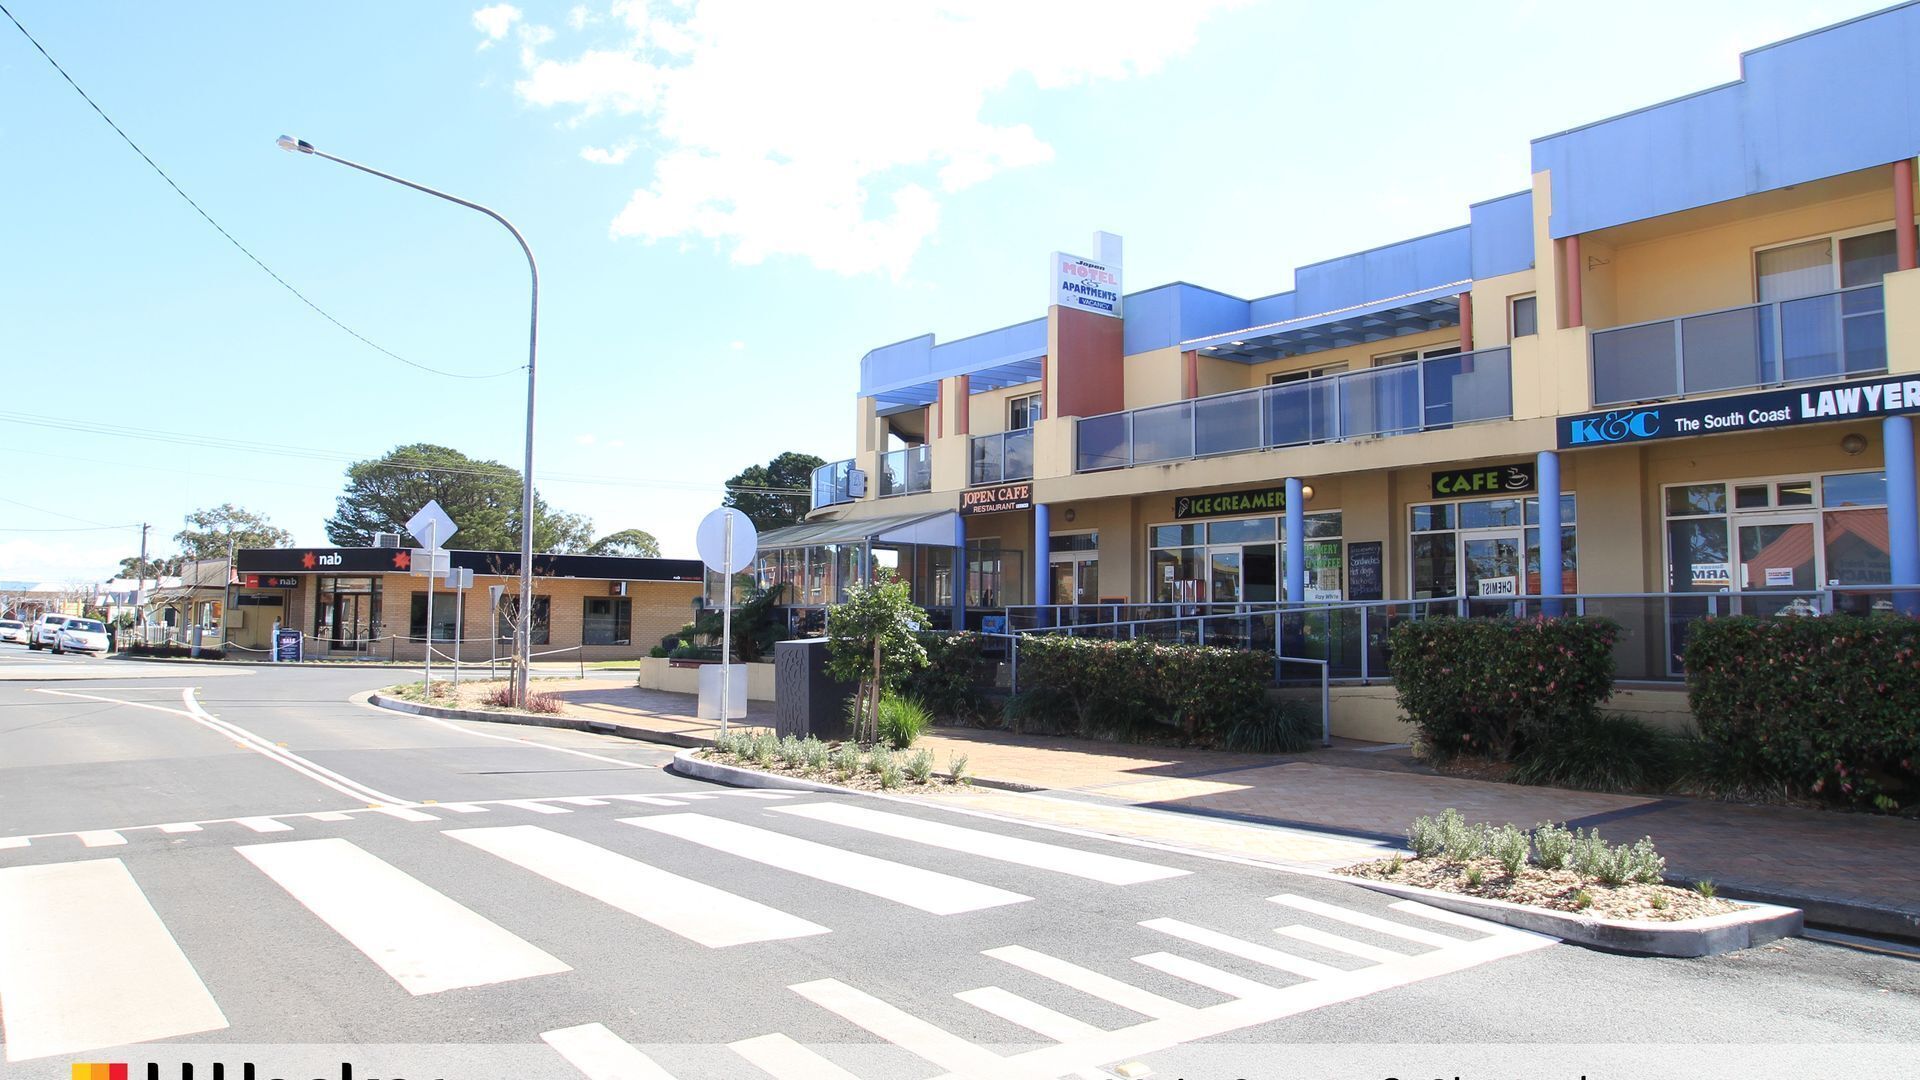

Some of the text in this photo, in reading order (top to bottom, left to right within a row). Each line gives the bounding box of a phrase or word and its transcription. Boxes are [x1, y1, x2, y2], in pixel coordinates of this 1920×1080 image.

[1062, 262, 1117, 285] MOTEL
[1062, 281, 1117, 302] APARTMENTS
[1081, 298, 1110, 309] VACANCY
[1569, 381, 1920, 444] K&C The South Coast LAWYER
[1436, 471, 1499, 493] CAFE
[962, 485, 1029, 509] JOPEN CAFE
[973, 502, 1016, 513] RESTAURANT
[1191, 492, 1286, 514] ICE CREAMER
[319, 552, 342, 566] nab
[280, 577, 297, 586] nab
